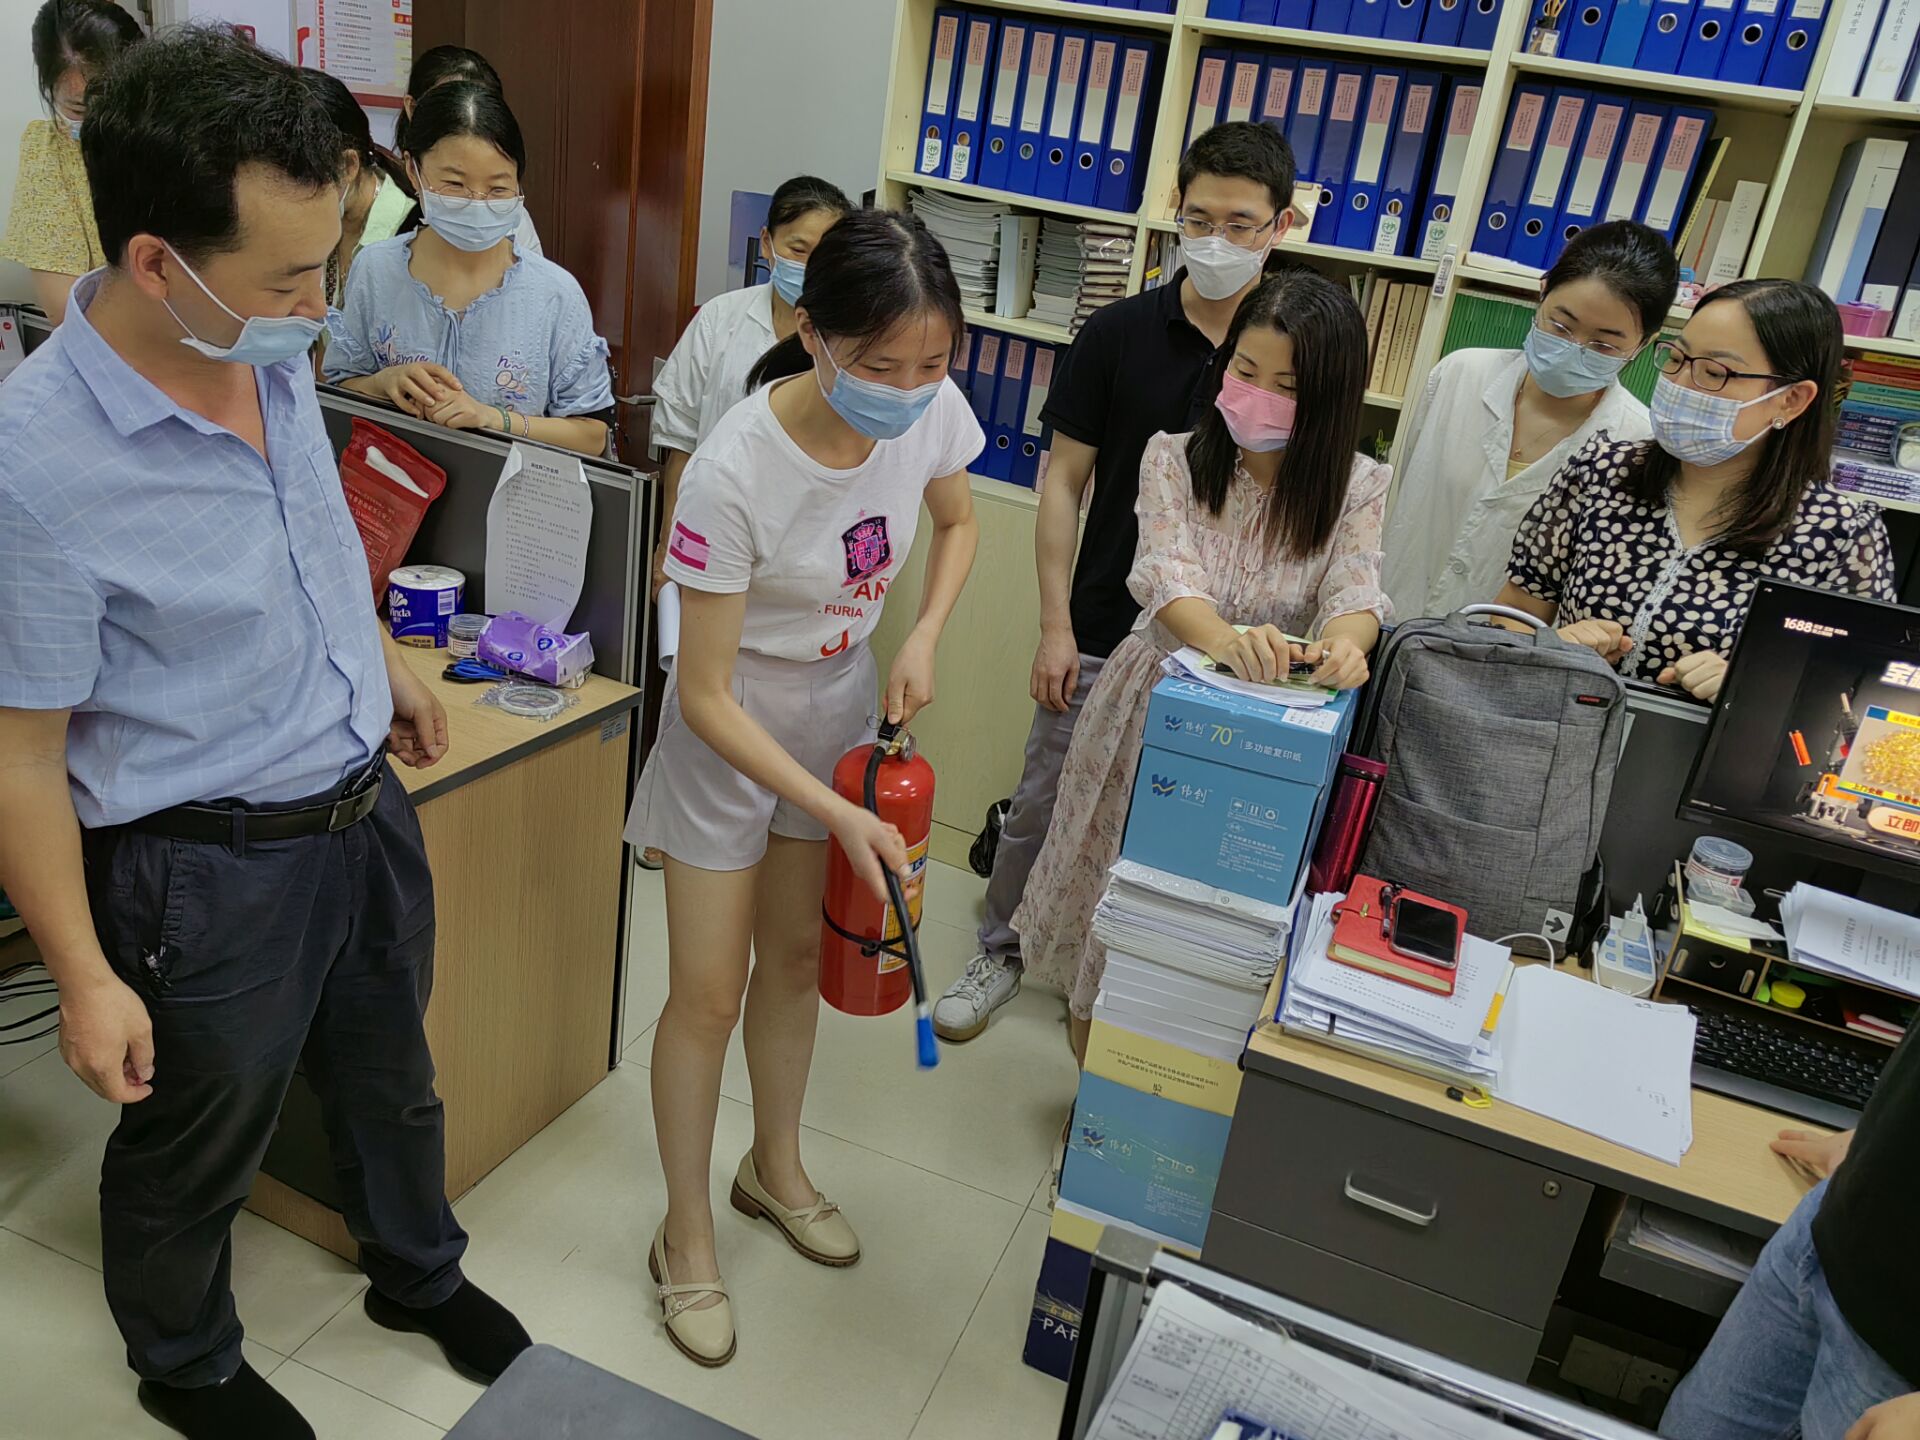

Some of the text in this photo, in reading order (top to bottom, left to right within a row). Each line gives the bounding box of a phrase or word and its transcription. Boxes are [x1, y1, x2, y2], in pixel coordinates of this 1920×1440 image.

[389, 607, 411, 617] Vinda
[824, 604, 863, 618] FURIA
[1783, 617, 1813, 633] 1688
[1210, 724, 1233, 746] 70
[1181, 783, 1208, 804] 伟创
